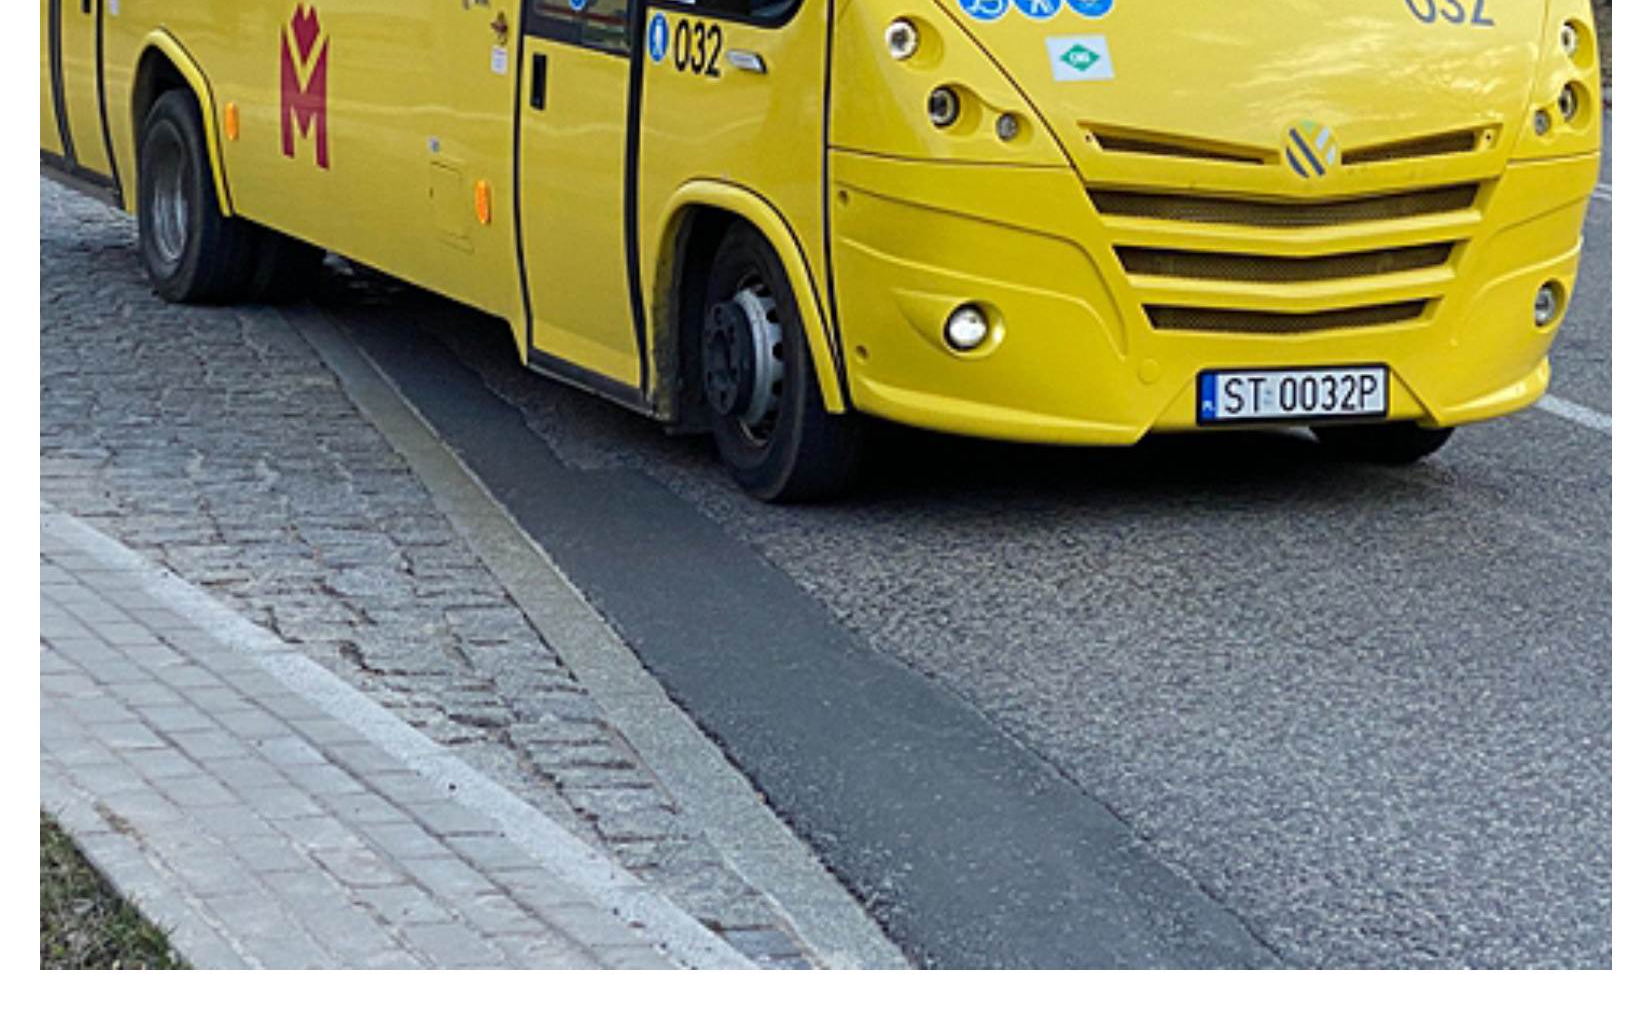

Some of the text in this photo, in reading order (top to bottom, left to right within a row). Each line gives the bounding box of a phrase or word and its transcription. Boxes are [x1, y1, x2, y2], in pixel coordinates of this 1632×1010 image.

[674, 19, 723, 79] 032
[1223, 374, 1378, 414] ST 0032P
